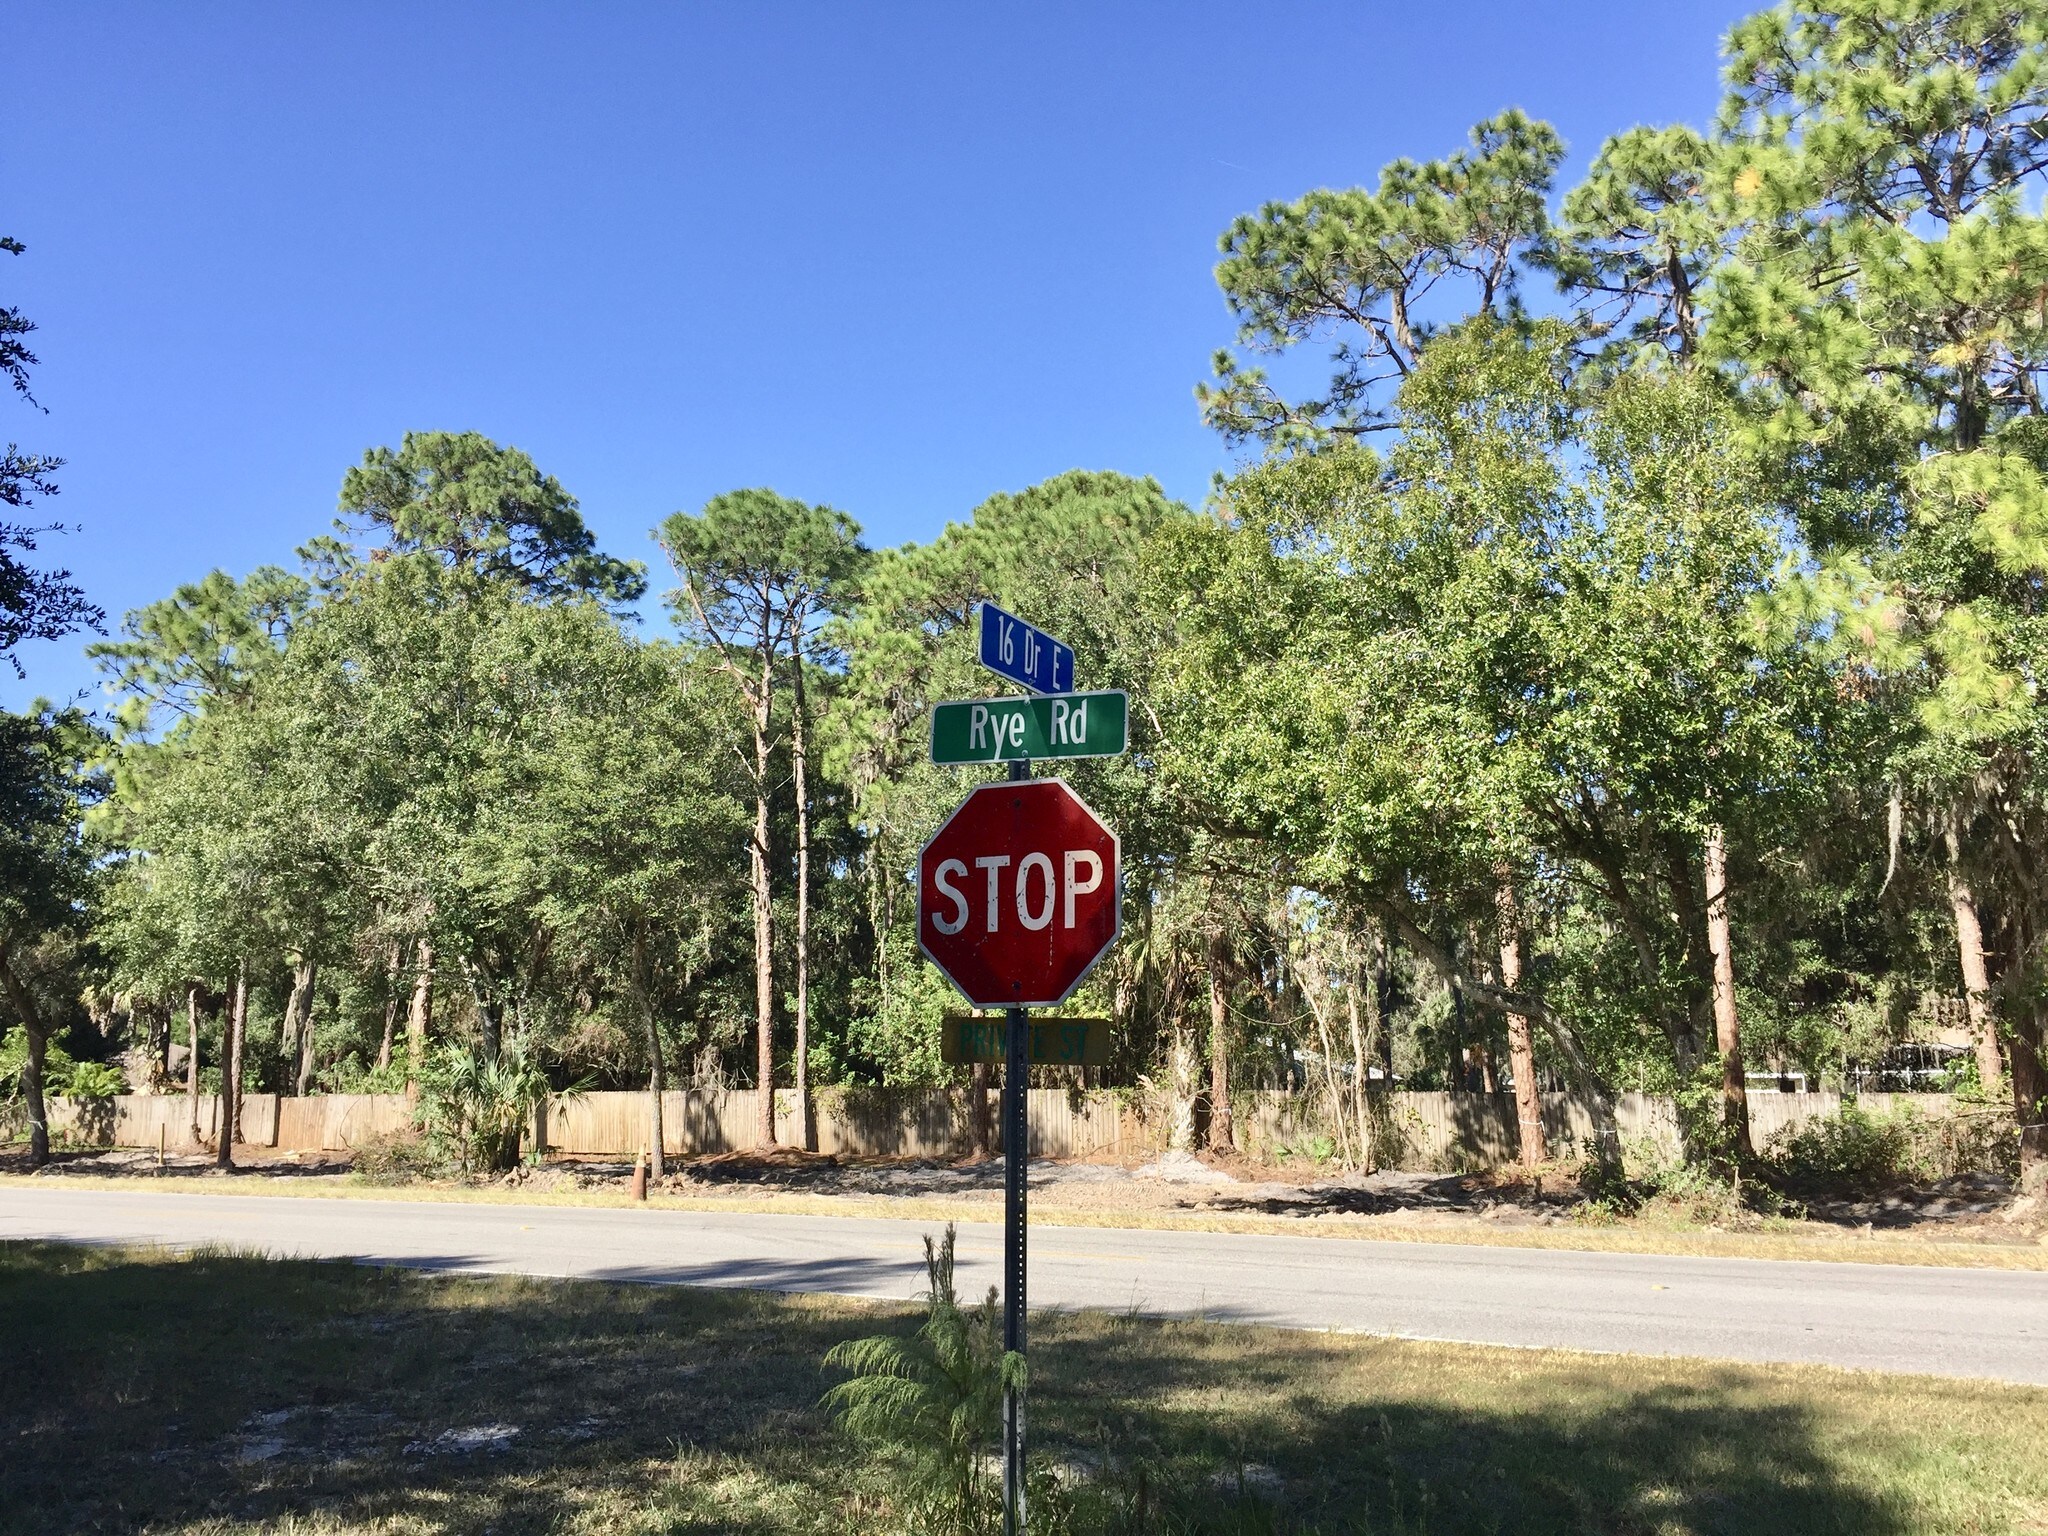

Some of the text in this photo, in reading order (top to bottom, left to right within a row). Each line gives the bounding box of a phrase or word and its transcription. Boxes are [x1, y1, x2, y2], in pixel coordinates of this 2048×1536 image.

[999, 615, 1061, 690] 16 Dr E
[970, 698, 1087, 760] Rye Rd
[932, 850, 1103, 935] STOP
[960, 1023, 1046, 1058] PRIVE
